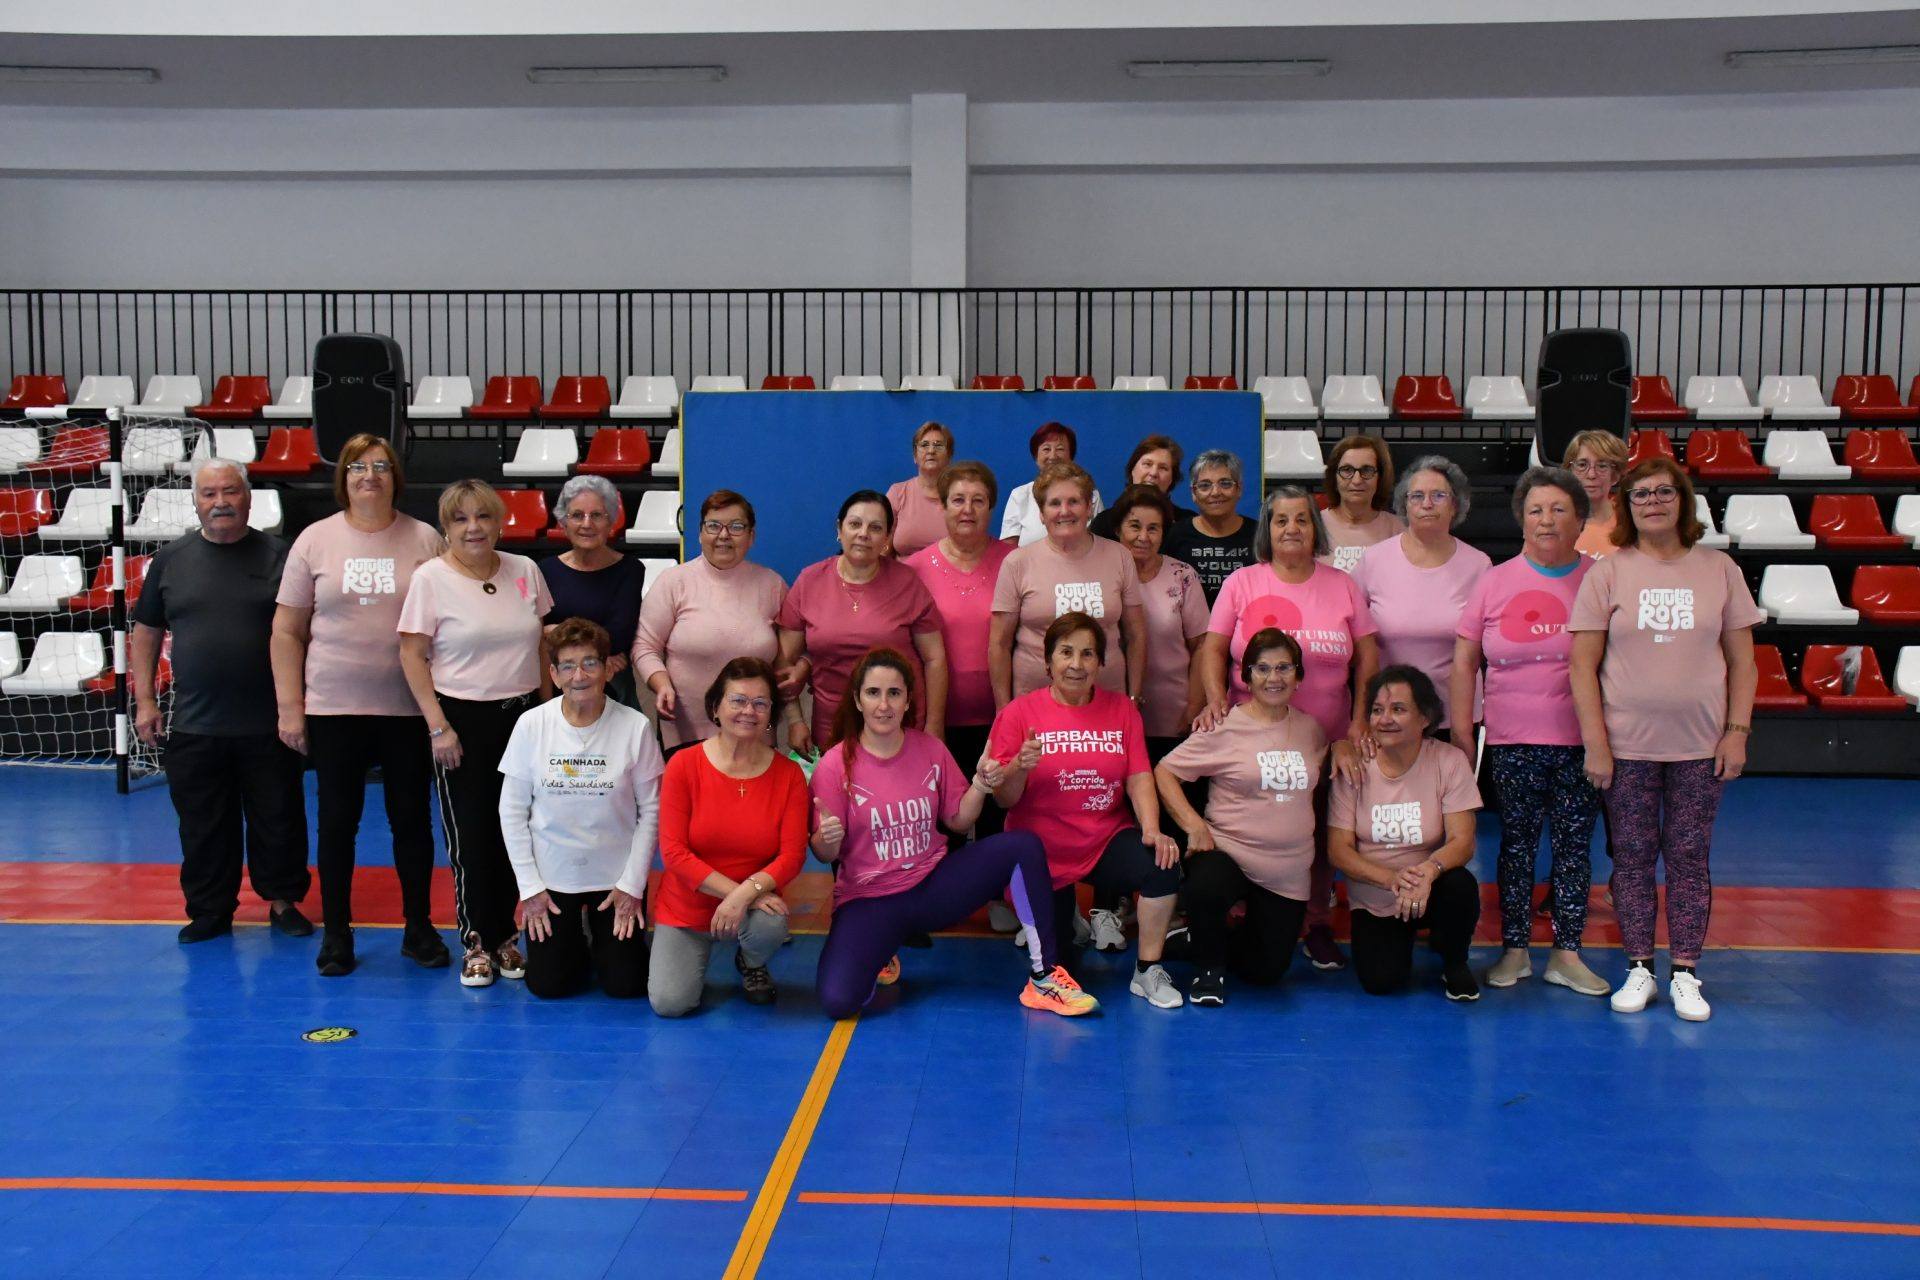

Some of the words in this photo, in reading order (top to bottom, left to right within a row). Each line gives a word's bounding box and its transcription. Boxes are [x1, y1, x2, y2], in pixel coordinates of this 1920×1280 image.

[1035, 730, 1123, 744] HERBALIFE
[549, 758, 607, 766] CAMINHADA
[541, 779, 564, 788] Vidas
[569, 778, 614, 789] Saudáveis
[871, 807, 884, 830] A
[886, 797, 932, 827] LION
[881, 823, 914, 841] KITTY
[915, 820, 932, 834] CAT
[874, 831, 931, 861] WORLD
